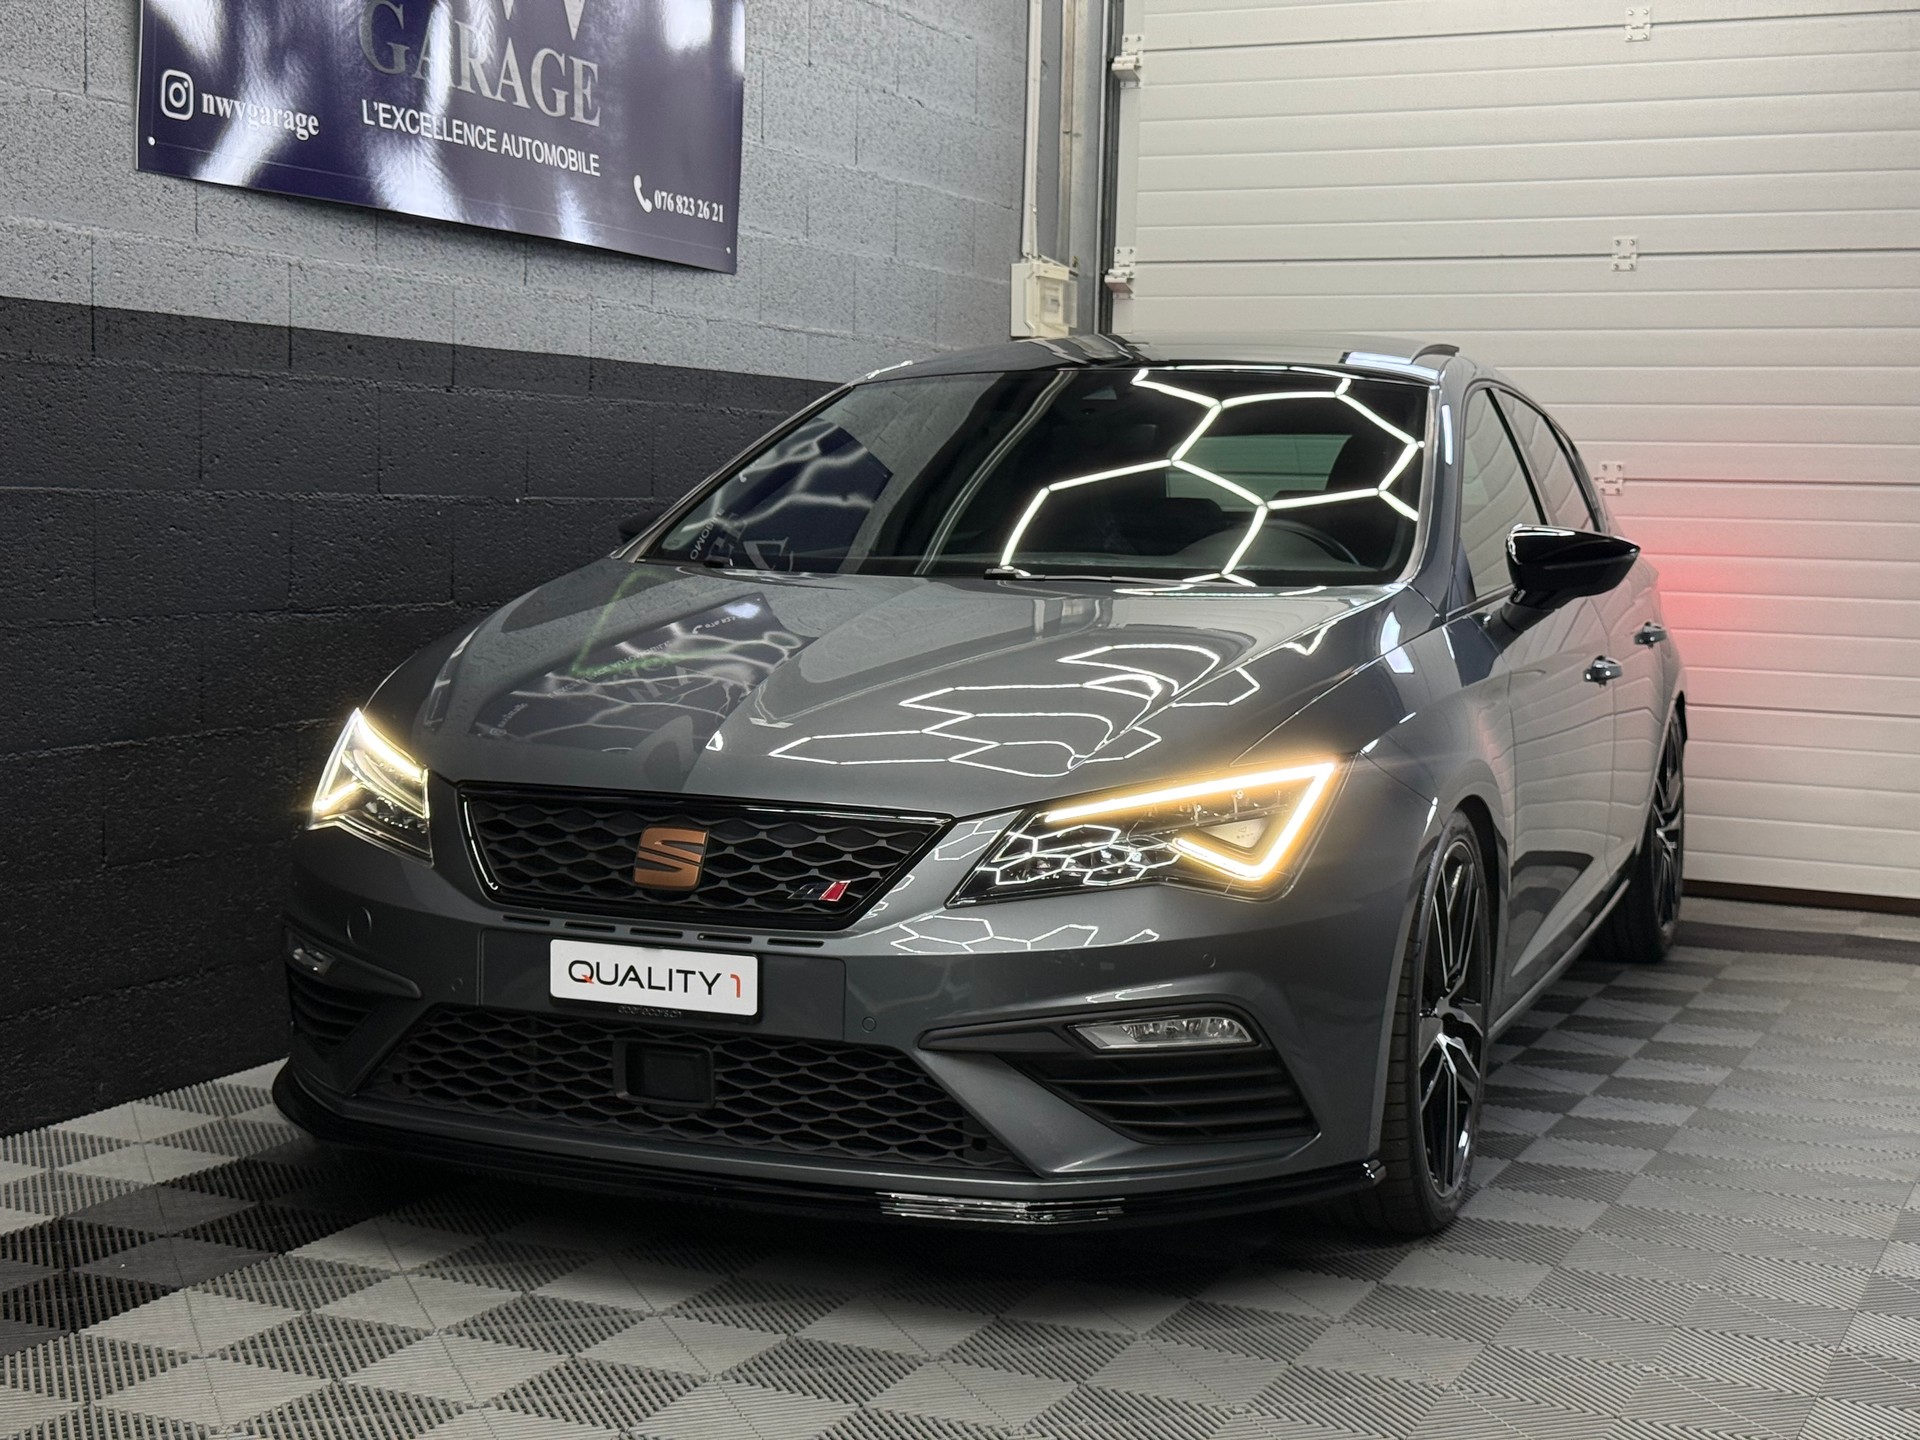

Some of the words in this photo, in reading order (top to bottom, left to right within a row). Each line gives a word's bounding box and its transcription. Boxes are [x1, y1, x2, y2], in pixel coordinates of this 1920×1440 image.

[201, 92, 320, 141] nwvgarage
[362, 99, 498, 153] L'EXCELLENCE
[501, 132, 601, 177] AUTOMOBILE
[654, 190, 675, 212] 076
[676, 195, 695, 217] 823
[697, 199, 710, 220] 26
[712, 202, 724, 223] 21
[568, 960, 722, 995] QUALITY
[730, 974, 741, 998] 1
